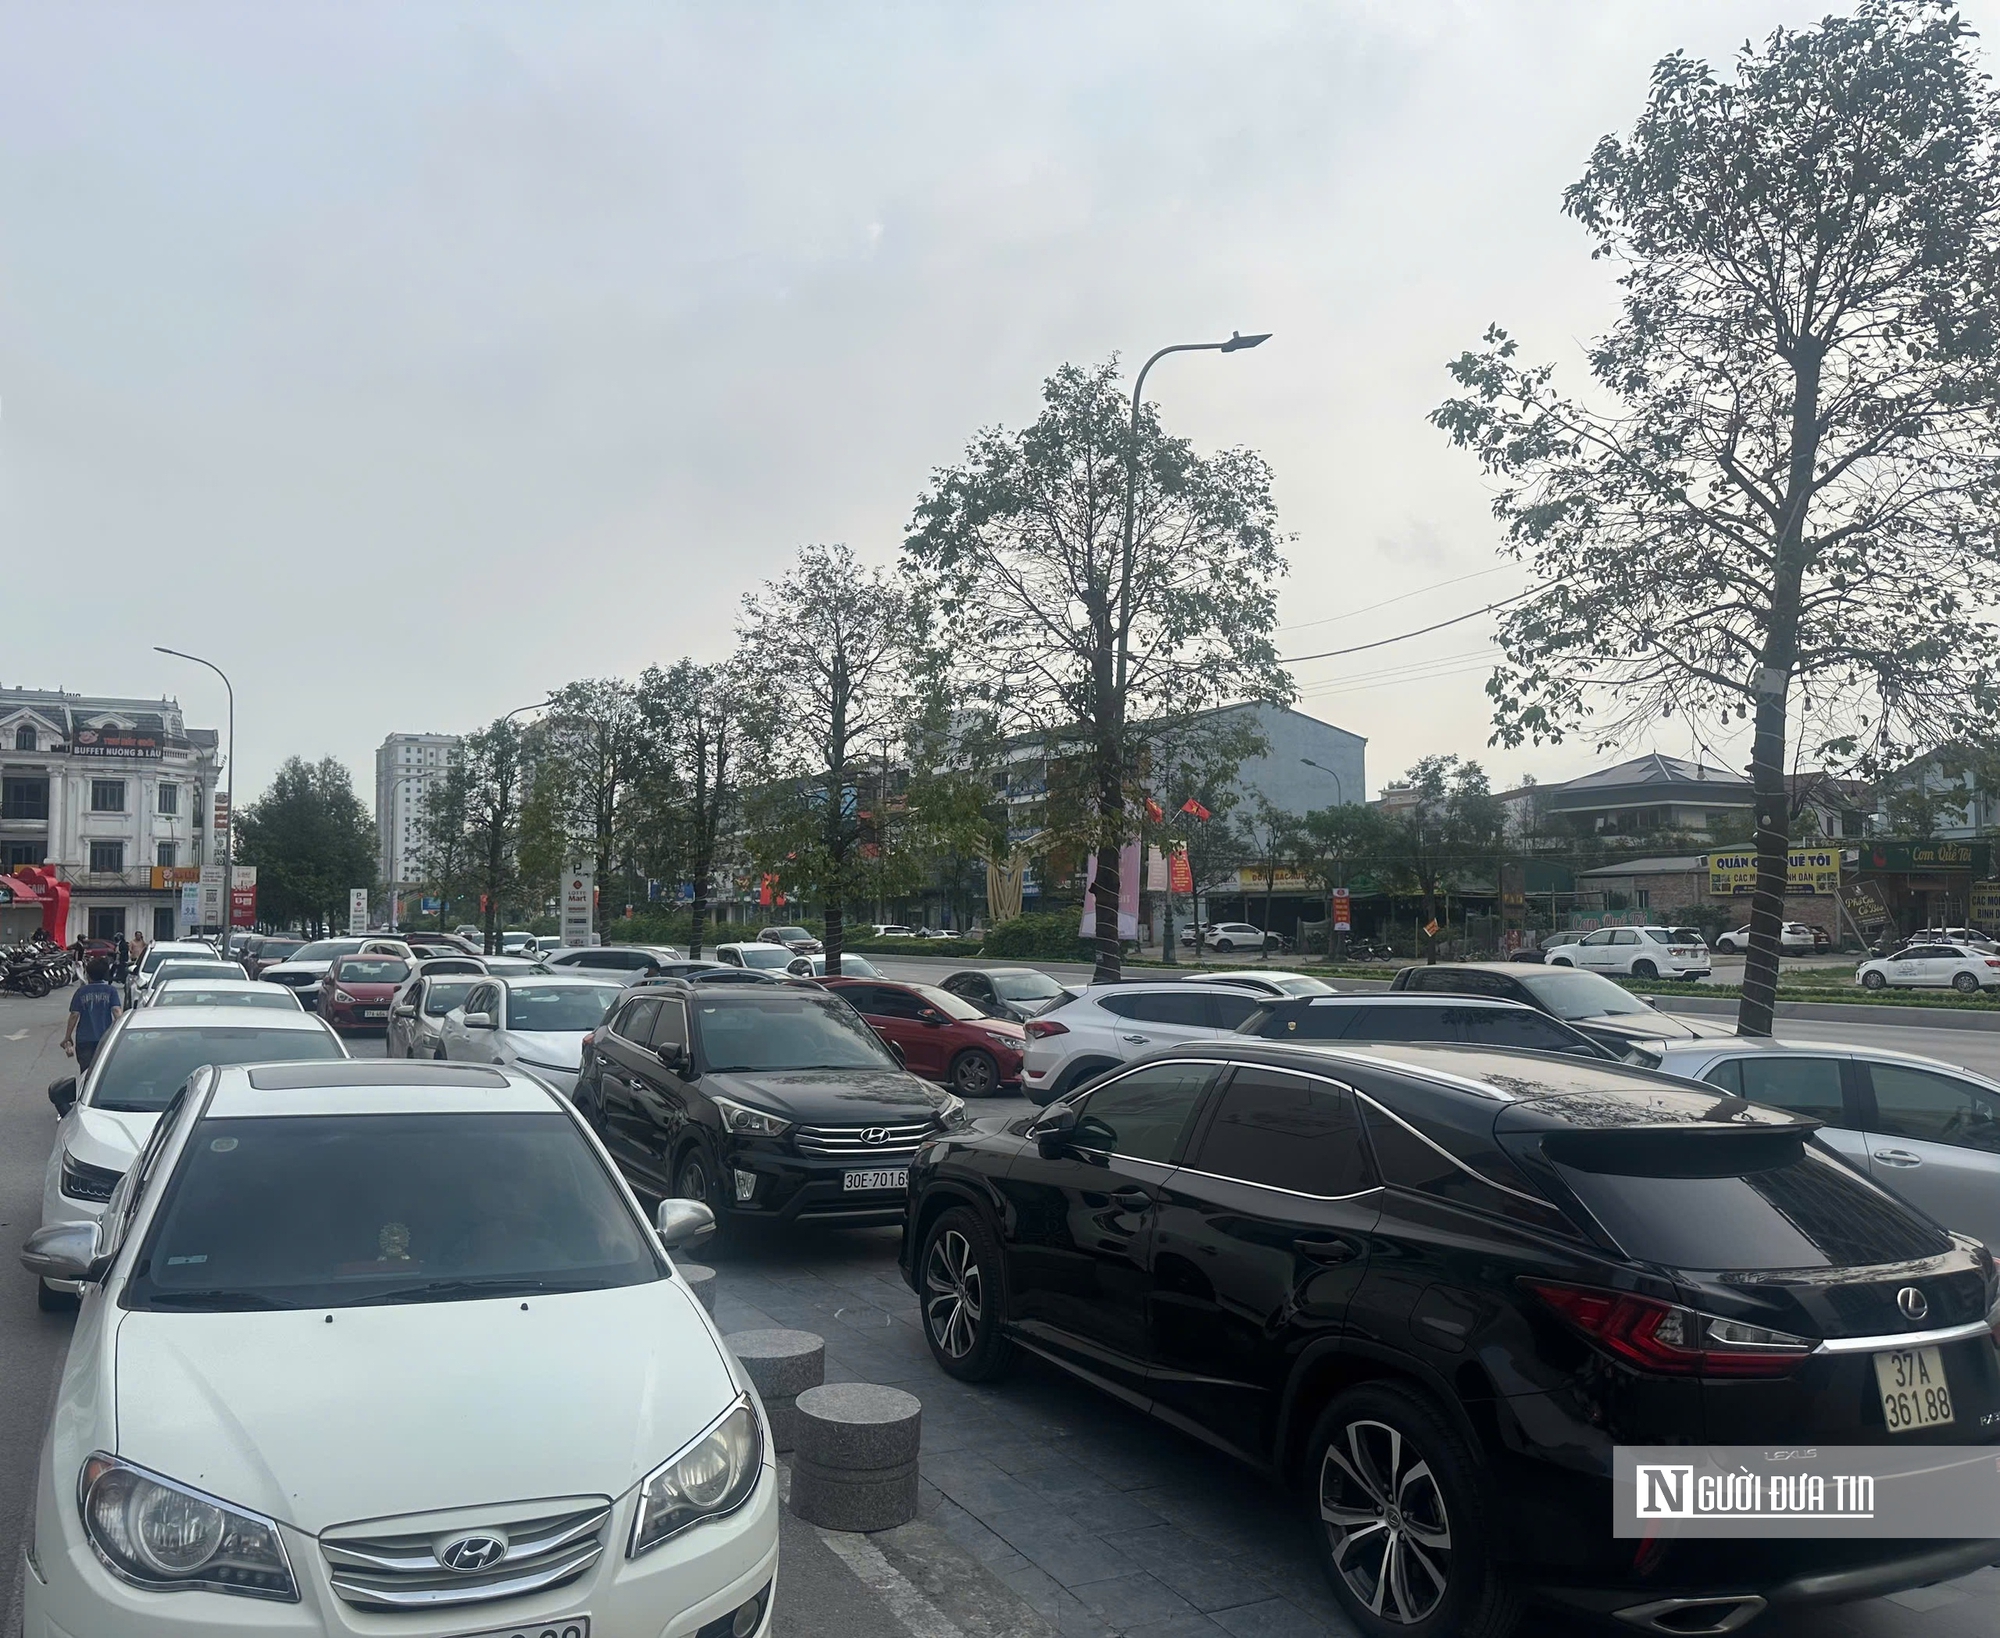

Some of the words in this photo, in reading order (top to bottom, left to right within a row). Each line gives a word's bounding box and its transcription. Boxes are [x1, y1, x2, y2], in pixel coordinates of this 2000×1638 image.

[74, 747, 104, 755] BUFFET
[1716, 854, 1748, 870] QUÁN
[1789, 852, 1805, 867] UÊ
[1808, 852, 1831, 867] TÔI
[1891, 1353, 1931, 1388] 37A
[1885, 1387, 1951, 1429] 361.88
[1764, 1448, 1817, 1461] LEXUS
